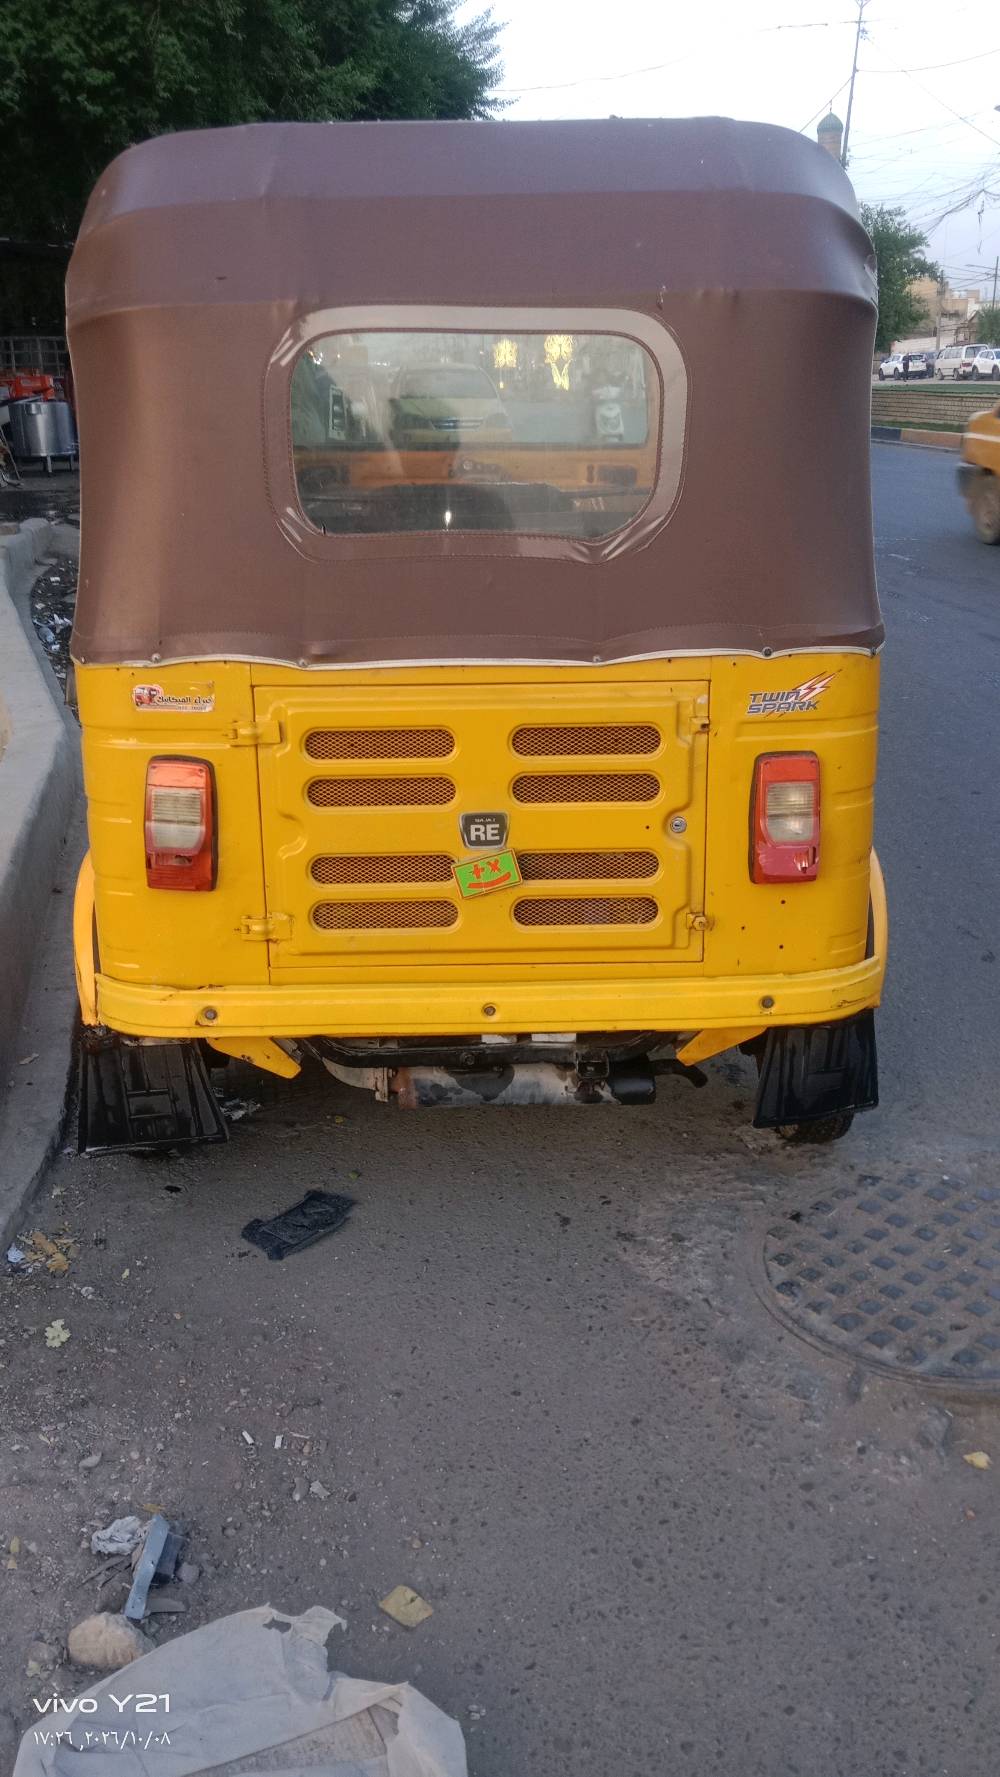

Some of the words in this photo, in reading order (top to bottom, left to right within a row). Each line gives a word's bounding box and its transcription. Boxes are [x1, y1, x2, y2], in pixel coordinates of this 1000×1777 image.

[749, 689, 801, 703] TWIN
[747, 700, 819, 714] SPARK
[470, 823, 500, 841] RE
